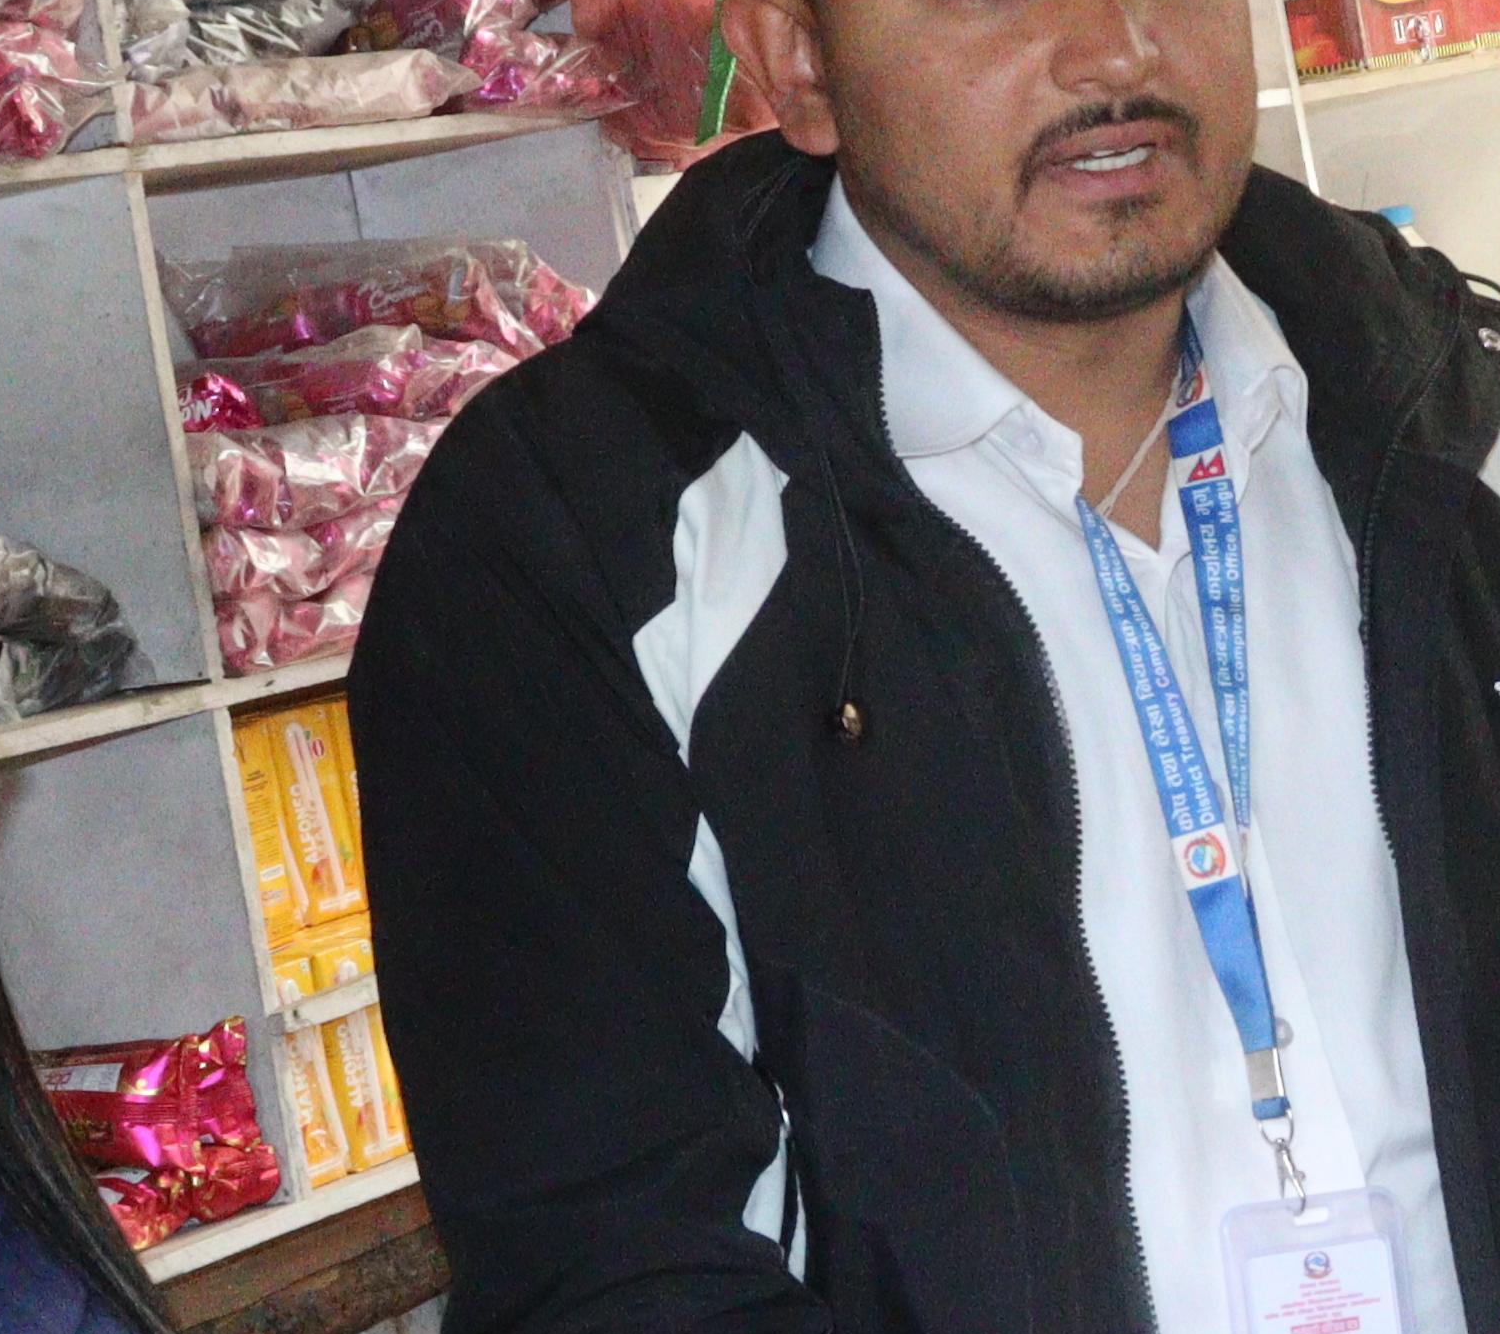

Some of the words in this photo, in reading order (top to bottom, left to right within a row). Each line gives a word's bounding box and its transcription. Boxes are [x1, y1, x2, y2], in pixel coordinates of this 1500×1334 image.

[1216, 479, 1235, 525] Mugu
[1223, 527, 1241, 582] Office,
[1124, 596, 1172, 689] Comptroller
[1230, 588, 1246, 682] Comptroller
[1142, 703, 1171, 748] लेखा
[1161, 691, 1198, 765] Treasury
[1159, 750, 1184, 789] तथा
[1184, 765, 1216, 824] District
